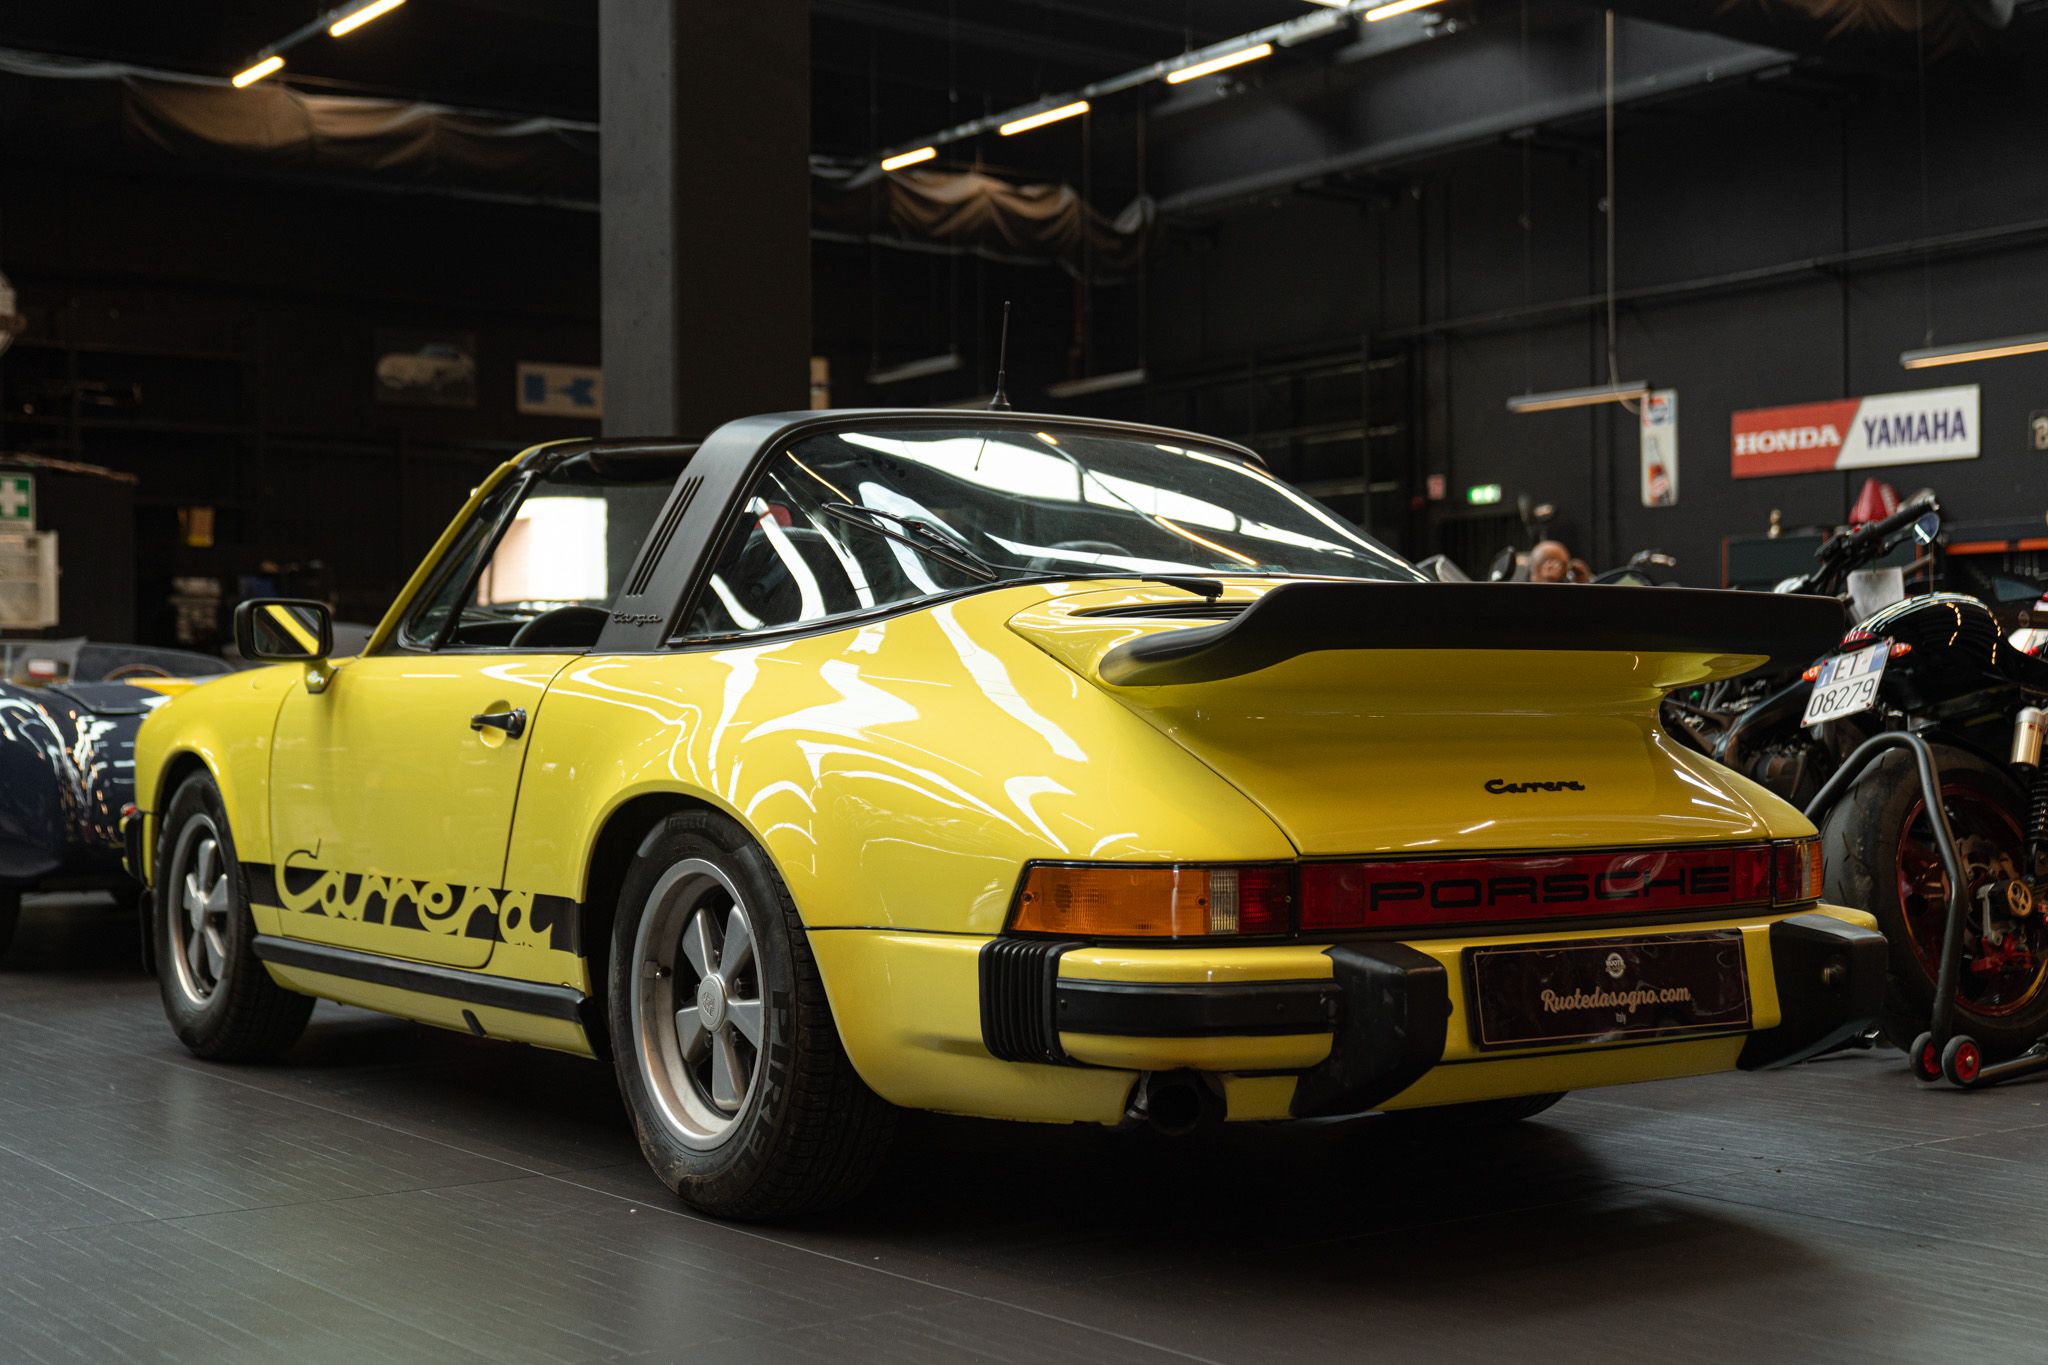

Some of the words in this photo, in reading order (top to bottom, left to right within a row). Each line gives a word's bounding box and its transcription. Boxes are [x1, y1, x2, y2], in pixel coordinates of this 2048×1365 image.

[1735, 424, 1840, 455] HONDA
[1863, 408, 1967, 448] YAMAHA
[1833, 650, 1864, 681] ET
[1809, 678, 1875, 717] 08279
[1484, 778, 1585, 794] Carrera
[275, 838, 551, 949] Carrera
[1369, 867, 1730, 911] PORSCHE
[1541, 986, 1691, 1013] Ruotedasogno.com
